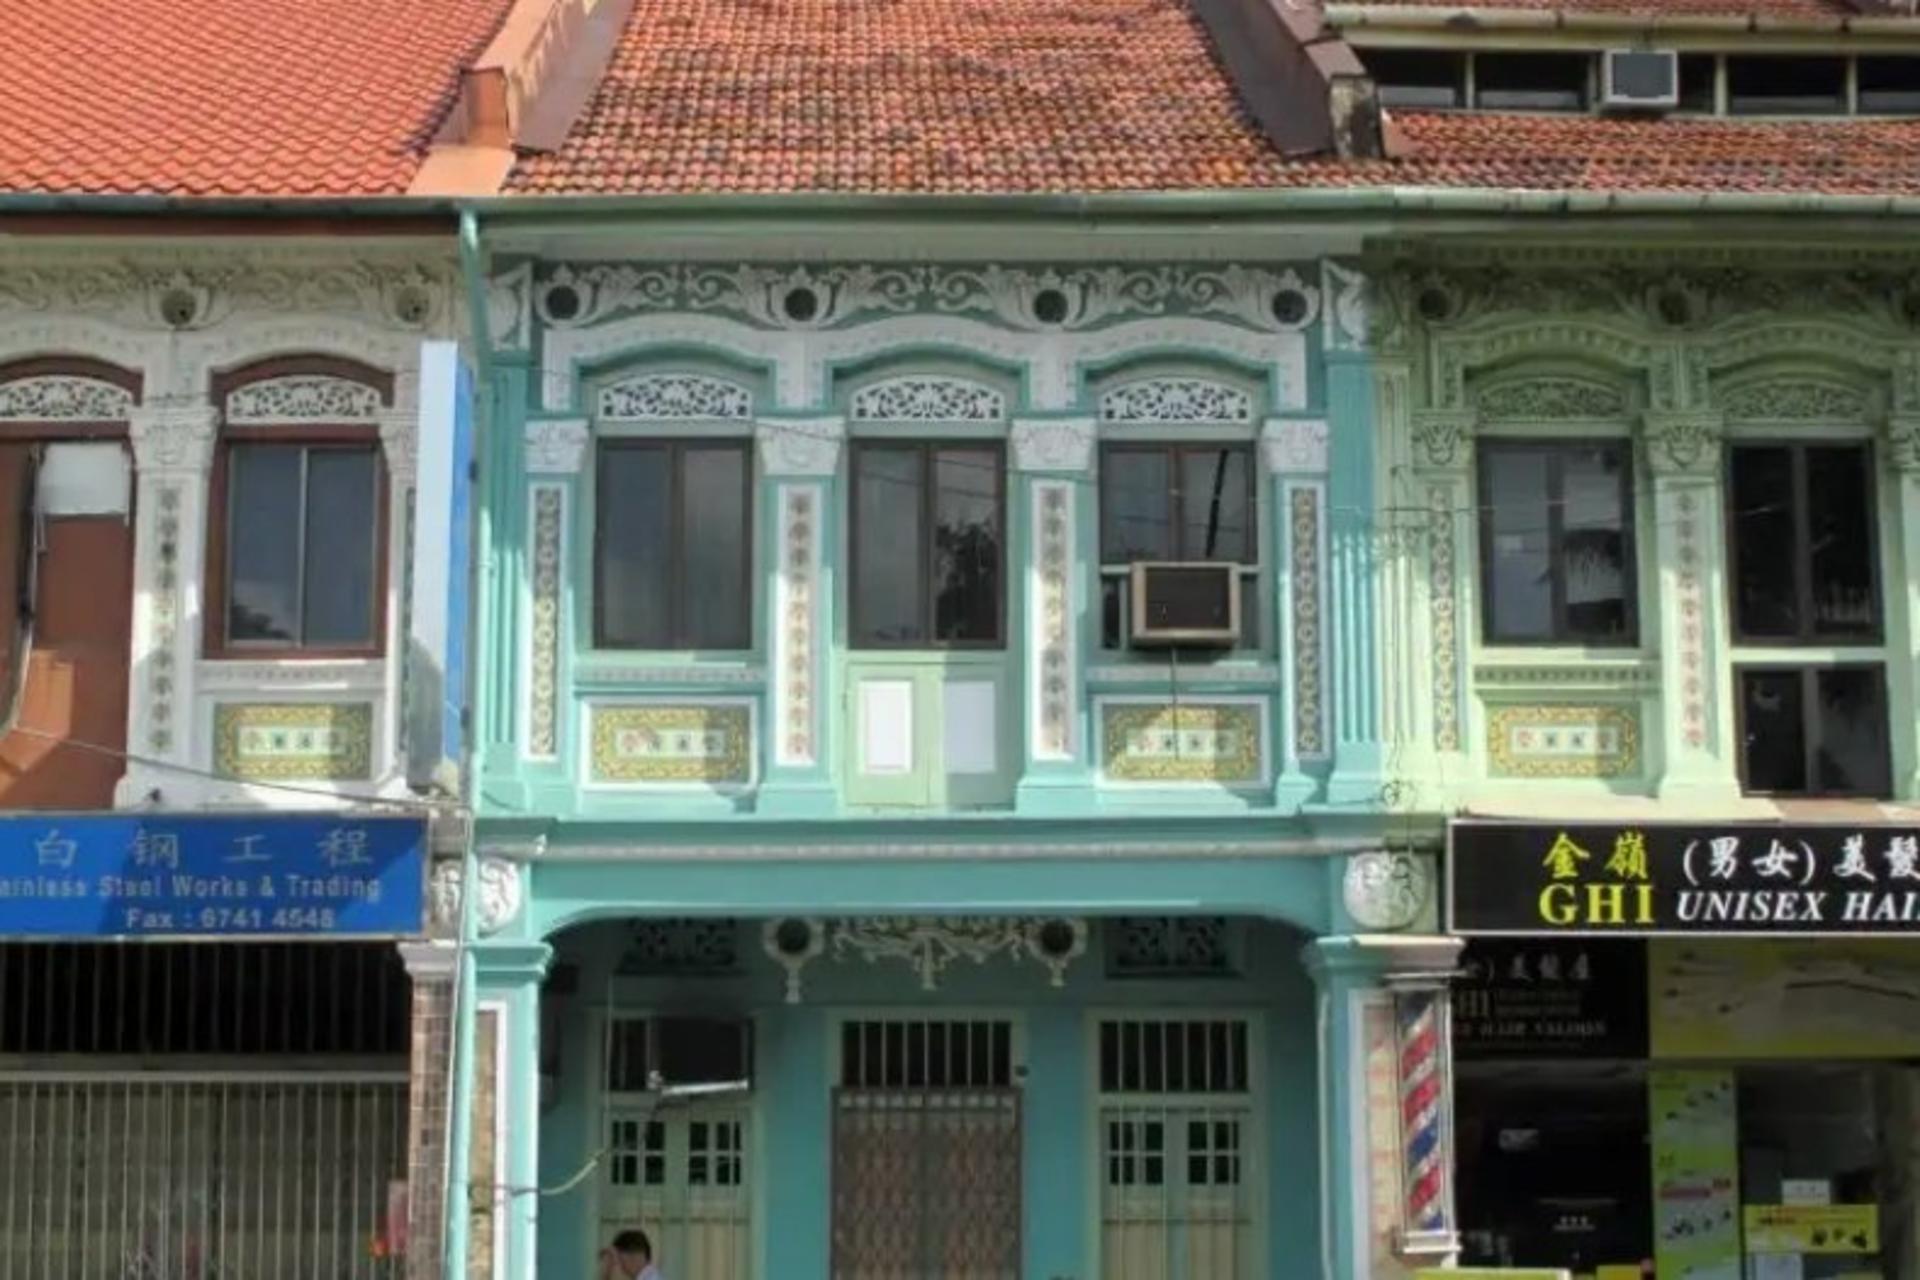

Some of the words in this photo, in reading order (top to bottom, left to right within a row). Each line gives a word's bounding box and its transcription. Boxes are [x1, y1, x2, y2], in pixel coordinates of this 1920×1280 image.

[35, 827, 375, 869] 白钢工程
[1542, 831, 1648, 879] 金嶺
[99, 875, 161, 897] Steel
[172, 875, 248, 897] Works
[260, 875, 276, 897] &
[287, 874, 381, 902] Trading
[1539, 883, 1655, 925] GHI
[1677, 890, 1827, 921] UNISEX
[1841, 890, 1920, 921] HAI
[127, 907, 173, 929] Fax
